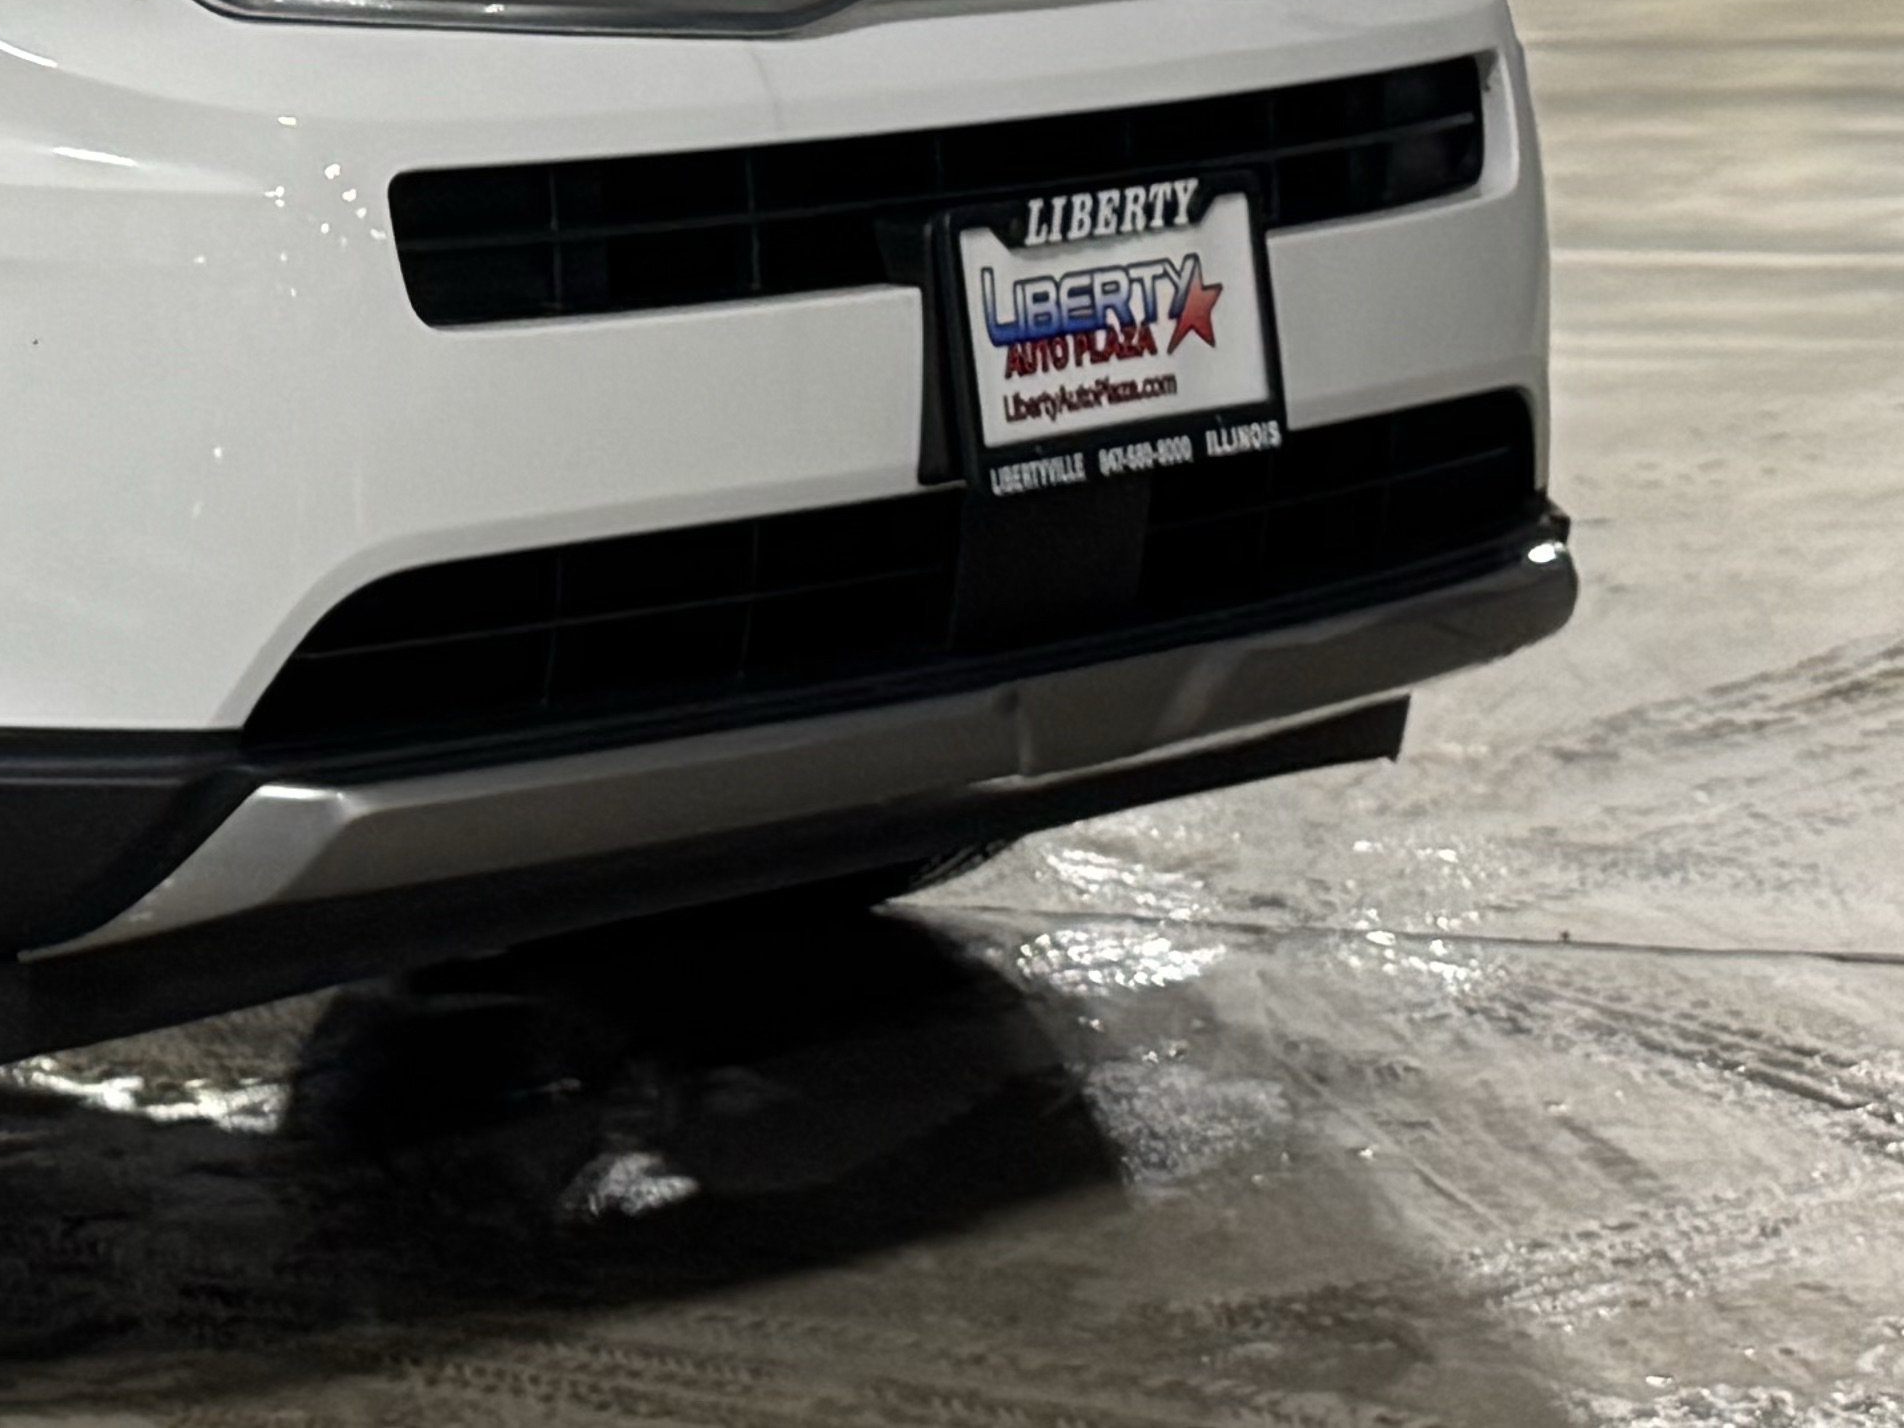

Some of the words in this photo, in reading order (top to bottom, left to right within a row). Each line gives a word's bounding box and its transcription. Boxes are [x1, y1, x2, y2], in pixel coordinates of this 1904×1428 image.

[1025, 178, 1198, 246] LIBERTY
[981, 253, 1199, 346] LIBERTY
[1005, 335, 1068, 378] AUTO
[1074, 324, 1157, 367] PLAZA
[1004, 374, 1177, 422] LibertyAutoPlaza.com
[991, 453, 1085, 495] LIBERTYVILLE
[1206, 421, 1281, 456] ILLINOIS
